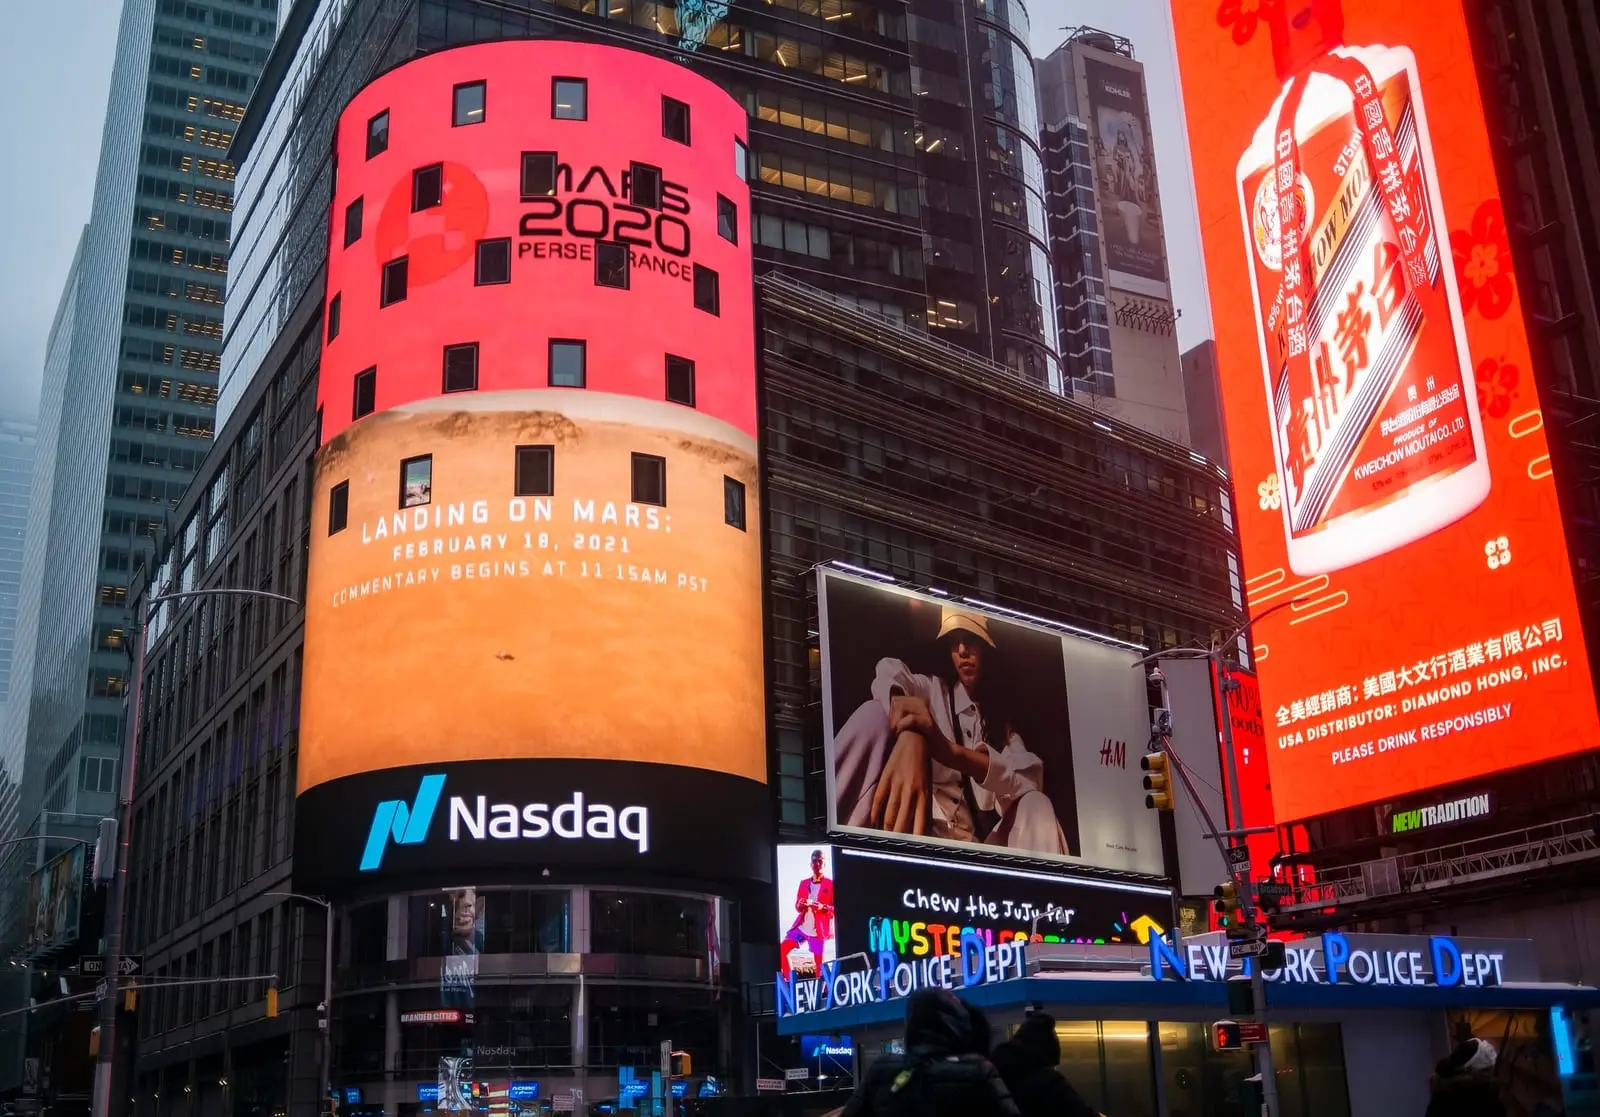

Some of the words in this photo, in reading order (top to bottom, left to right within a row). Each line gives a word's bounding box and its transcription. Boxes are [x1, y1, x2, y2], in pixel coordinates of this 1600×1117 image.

[519, 196, 691, 258] 2020
[518, 242, 691, 282] PERSERANCE
[1393, 424, 1425, 446] PRODUCE
[1428, 417, 1437, 429] OF
[1354, 448, 1404, 480] KWEICHOW
[1404, 431, 1437, 457] MOUTAI
[362, 499, 488, 544] LANDING
[509, 498, 552, 522] ON
[573, 499, 671, 534] MARS:
[393, 533, 507, 561] FEBRUARY
[524, 532, 559, 551] 18,
[573, 533, 630, 554] 2021
[332, 567, 440, 608] COMMENTARY
[451, 560, 530, 580] BEGINS
[542, 560, 567, 576] AT
[678, 572, 709, 593] PST
[1278, 727, 1304, 749] USA
[1307, 703, 1398, 740] DISTRIBUTOR:
[1402, 681, 1472, 714] DIAMOND
[1477, 665, 1529, 692] HONG,
[1532, 653, 1568, 675] INC.
[1099, 737, 1126, 770] H&M
[1332, 743, 1374, 765] PLEASE
[1378, 729, 1418, 752] DRINK
[1421, 703, 1514, 741] RESPONSIBLY
[449, 791, 648, 853] Nasdaq
[965, 895, 999, 919] the
[1150, 926, 1229, 982] NEW
[1322, 931, 1425, 985] POLICE
[1430, 934, 1504, 987] DEPT
[1232, 944, 1245, 955] ONE
[776, 971, 821, 1017] NEW
[821, 961, 875, 1009] YORK
[878, 950, 953, 1000] POLICE
[961, 934, 1026, 987] DEPT
[825, 1046, 853, 1056] Nasdaq
